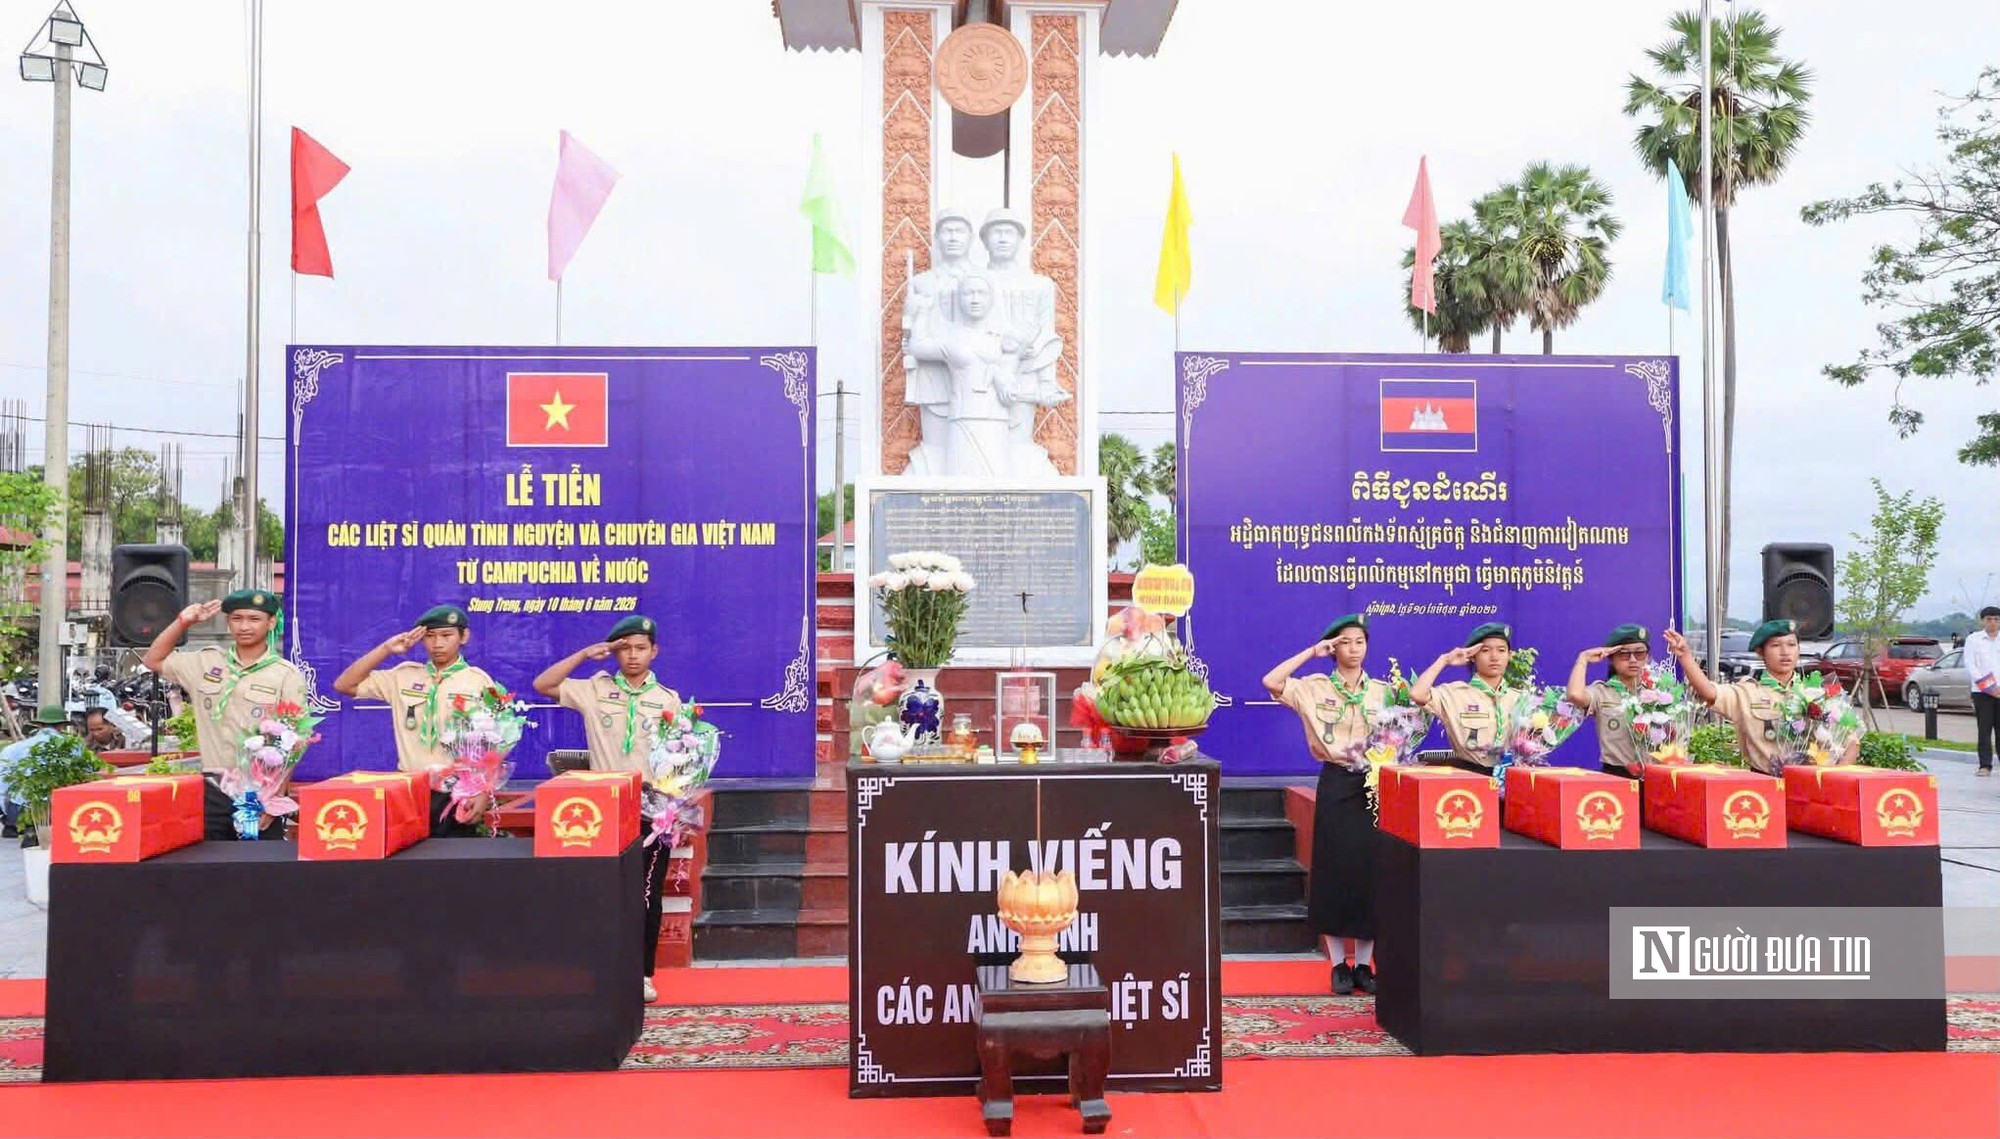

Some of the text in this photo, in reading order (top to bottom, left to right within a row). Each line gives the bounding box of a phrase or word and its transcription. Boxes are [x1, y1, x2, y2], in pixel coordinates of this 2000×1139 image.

[505, 463, 601, 506] LỄ TIỄN
[1351, 470, 1508, 509] ពិធីជូនដំណើរ
[327, 519, 776, 550] CÁC LIỆT SĨ QUÂN TÌNH NGUYỆN VÀ CHUYÊN GIA VIỆT NAM
[456, 554, 649, 585] TỪ CAMPUCHIA VỀ NƯỚC
[468, 597, 495, 614] Stung
[523, 596, 547, 614] ngày
[547, 597, 560, 612] 10
[559, 596, 586, 613] tháng
[585, 597, 594, 612] 6
[592, 596, 614, 612] năm
[884, 822, 1183, 894] KÍNH VIẾNG
[877, 972, 1191, 1030] CÁC AN IỆT SĨ
